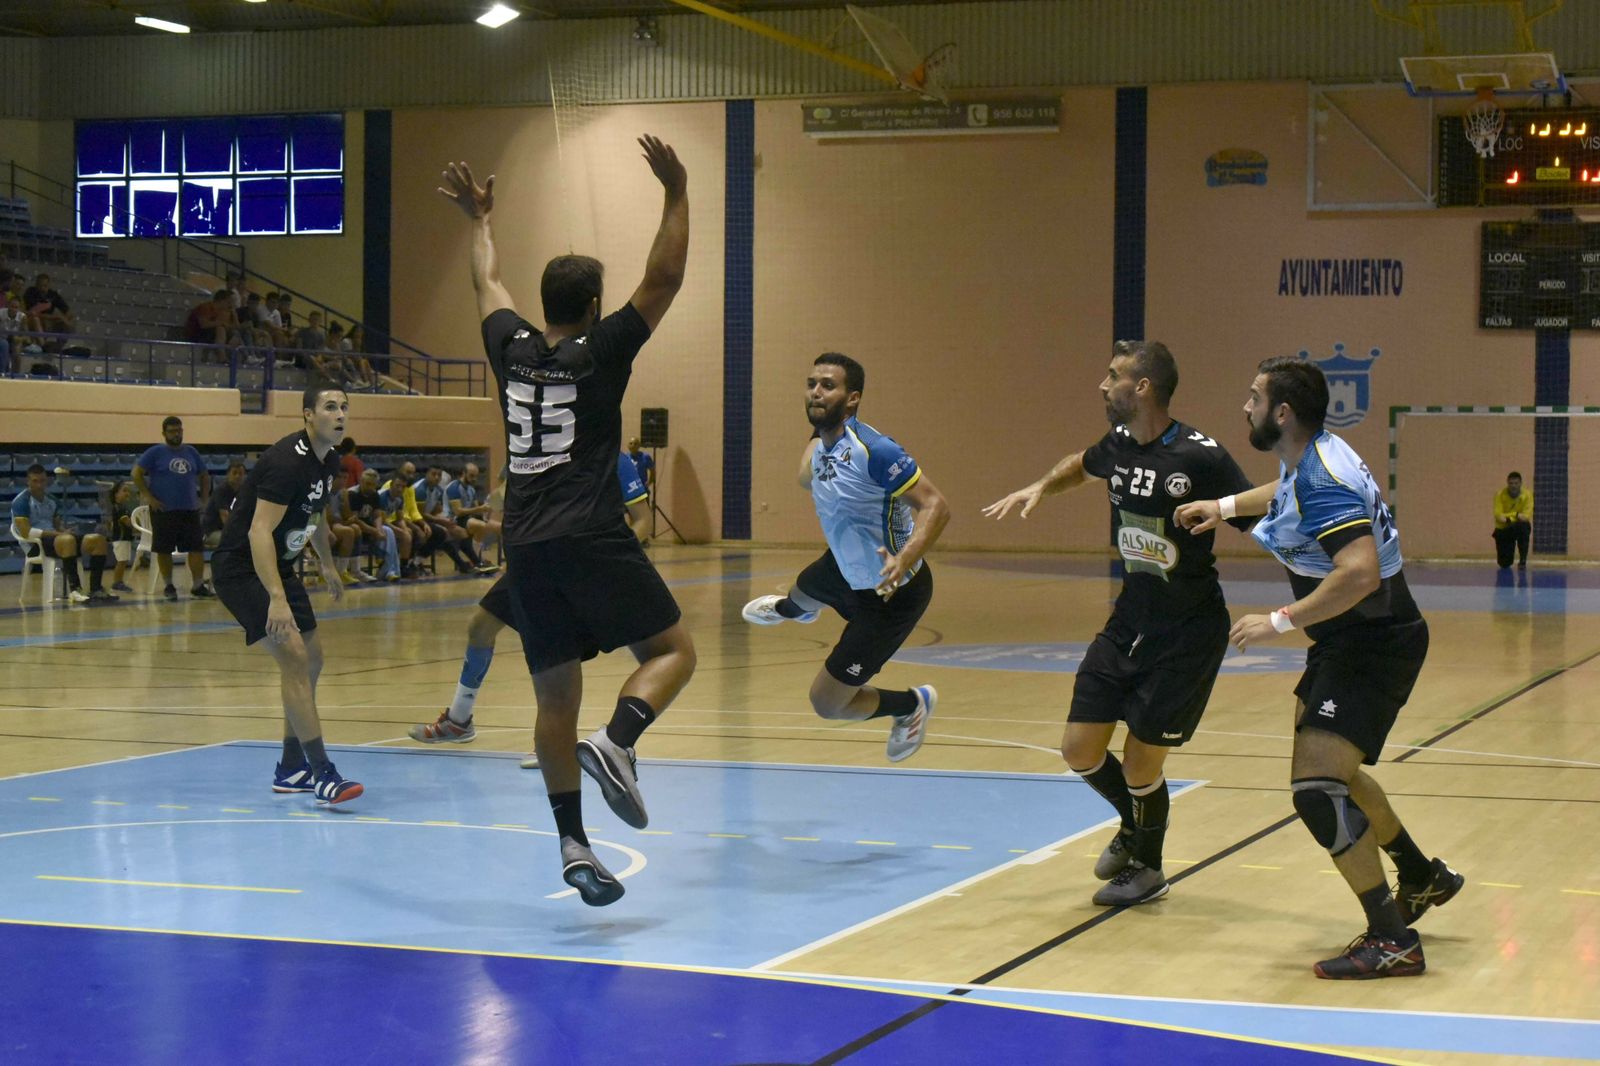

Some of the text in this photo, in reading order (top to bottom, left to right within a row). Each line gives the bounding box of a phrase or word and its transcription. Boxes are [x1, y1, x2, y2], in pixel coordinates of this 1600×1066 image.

[1498, 137, 1524, 151] LOC
[1488, 252, 1526, 263] LOCAL
[1278, 258, 1403, 297] AYUNTAMIENTO
[1538, 280, 1566, 289] PERIODO
[1485, 317, 1512, 326] FALTAS
[1534, 317, 1568, 327] JUGADOR
[505, 381, 577, 453] 55
[1129, 466, 1156, 497] 23
